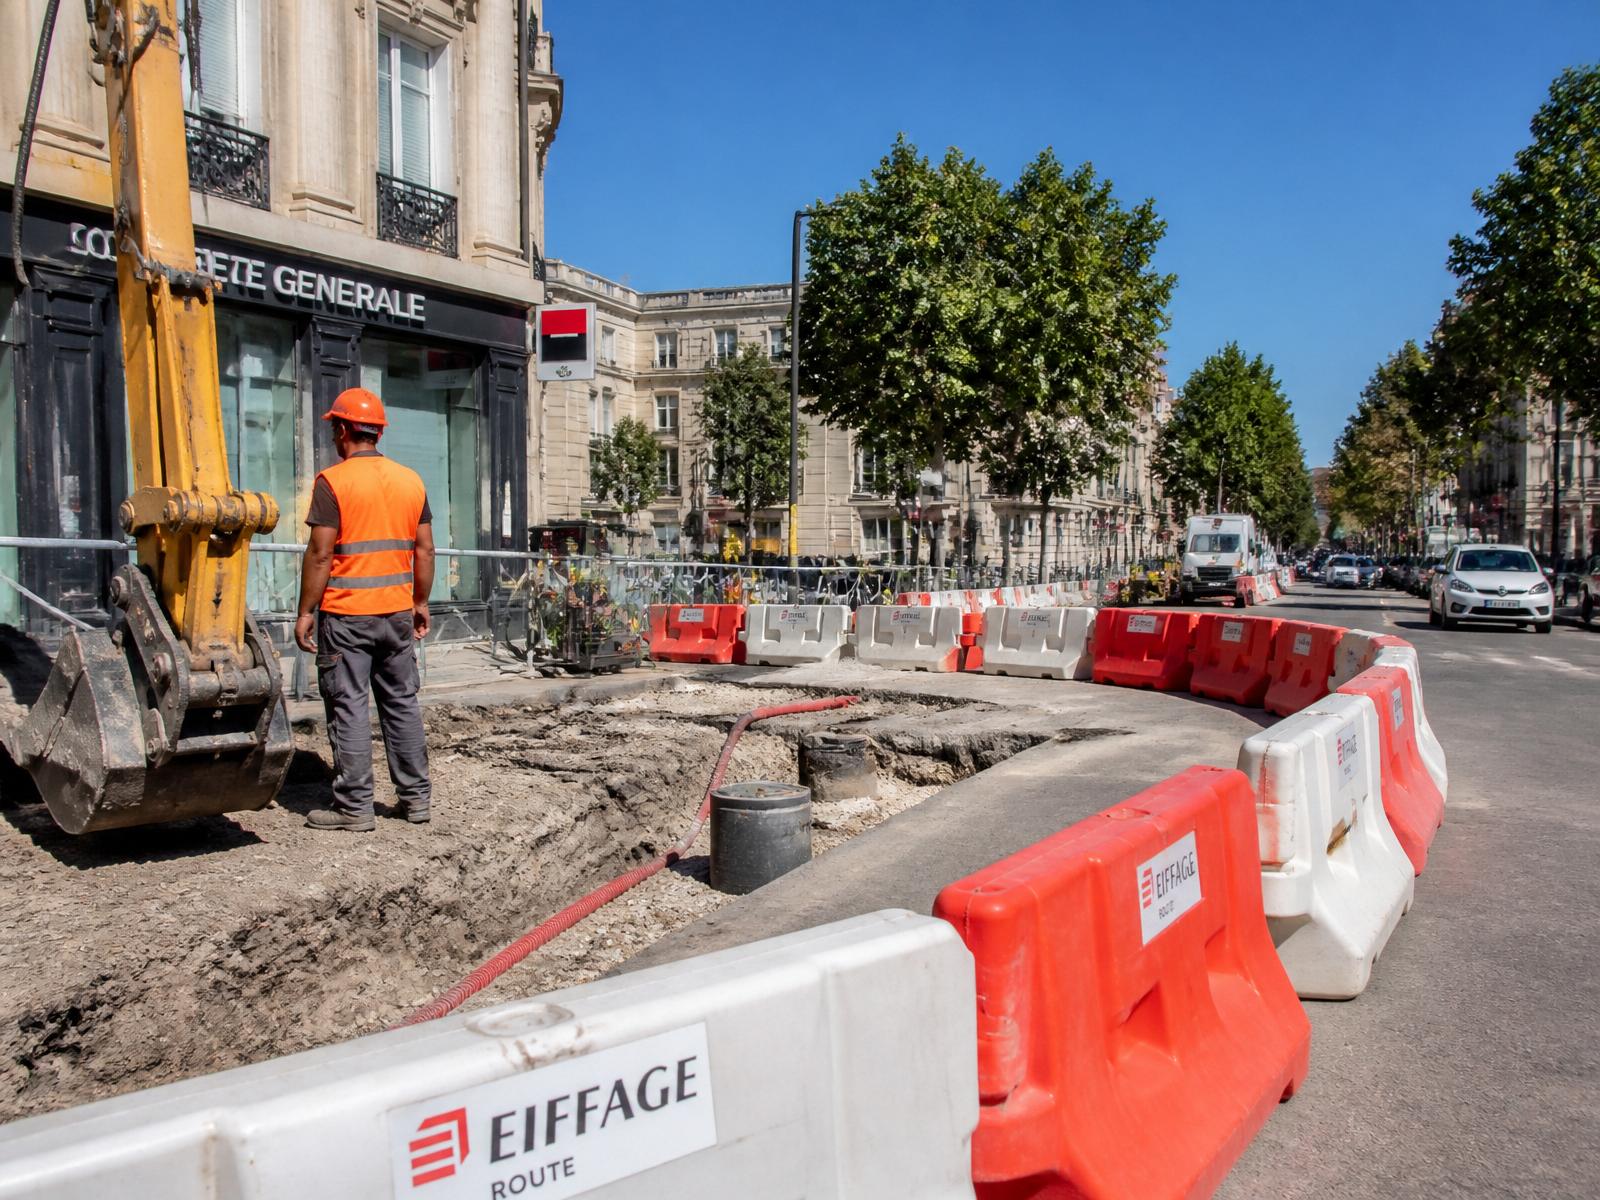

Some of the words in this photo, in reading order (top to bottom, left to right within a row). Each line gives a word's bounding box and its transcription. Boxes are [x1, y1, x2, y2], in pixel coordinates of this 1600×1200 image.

[273, 265, 426, 321] GENERALE
[1156, 851, 1196, 899] EIFFAGE
[489, 1055, 697, 1164] EIFFAGE
[491, 1156, 575, 1200] ROUTE
